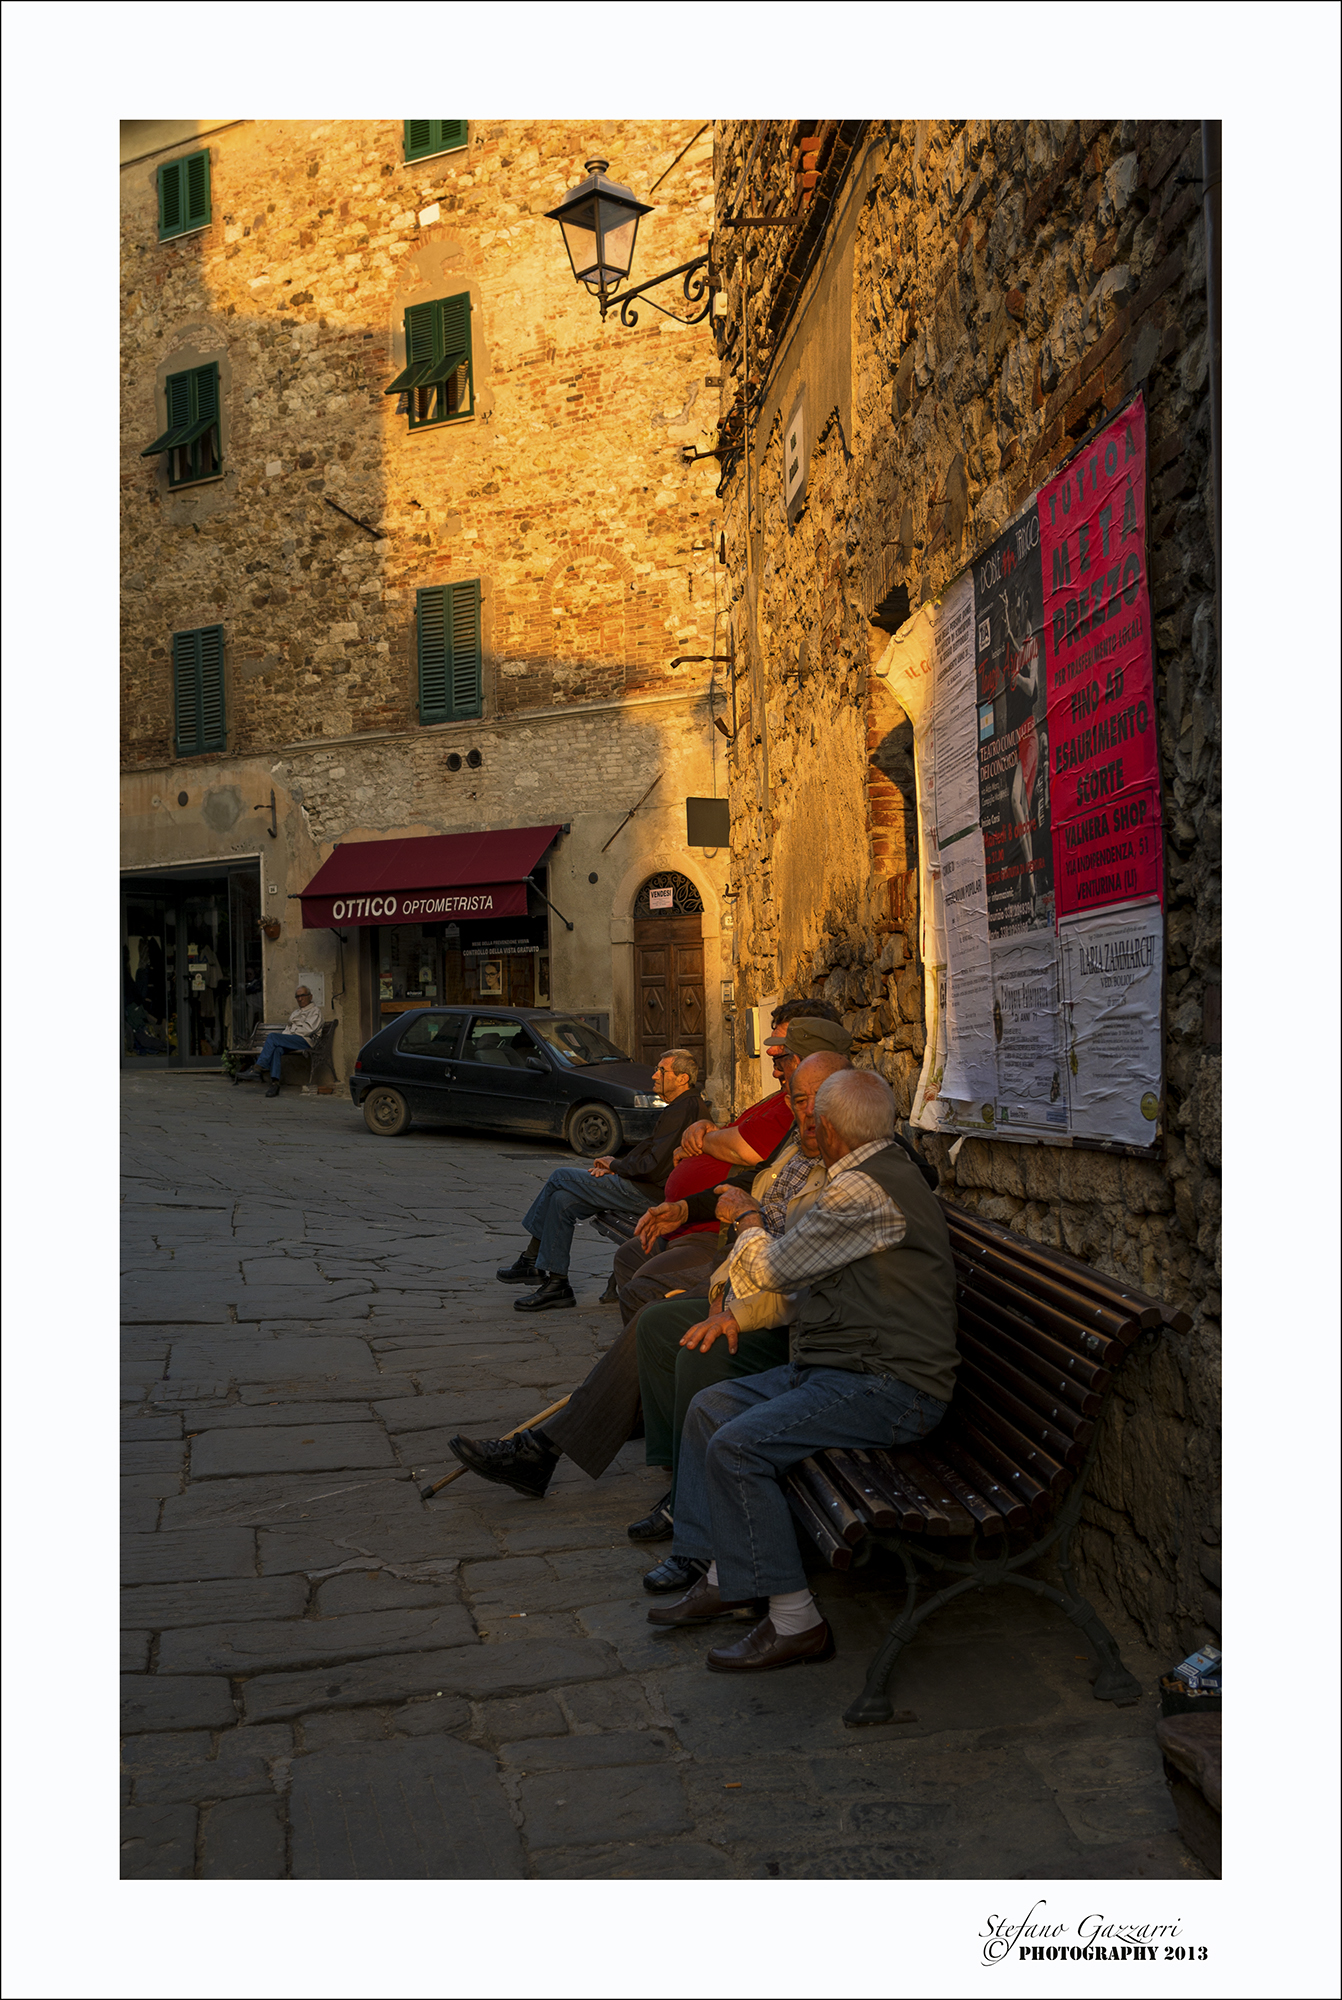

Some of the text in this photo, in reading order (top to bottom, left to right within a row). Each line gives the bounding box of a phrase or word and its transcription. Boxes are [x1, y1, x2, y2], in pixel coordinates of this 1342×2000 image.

[1048, 441, 1118, 526] TUTTO
[1053, 552, 1140, 657] PREZZO
[1055, 667, 1066, 690] PER
[1067, 633, 1116, 681] TRASFERIMENTO
[1071, 667, 1124, 724] FINO AD
[980, 738, 1001, 763] TEATRO
[1056, 700, 1148, 775] ESAURIMENTO
[1077, 758, 1123, 807] SCORTE
[1008, 822, 1013, 841] 8
[1113, 800, 1147, 832] SHOP
[651, 890, 671, 898] VENDESI
[1077, 873, 1121, 899] VENTURINA
[333, 895, 493, 920] OTTICO OPTOMETRISTA
[489, 947, 503, 955] DELLA
[504, 946, 516, 954] VISTA
